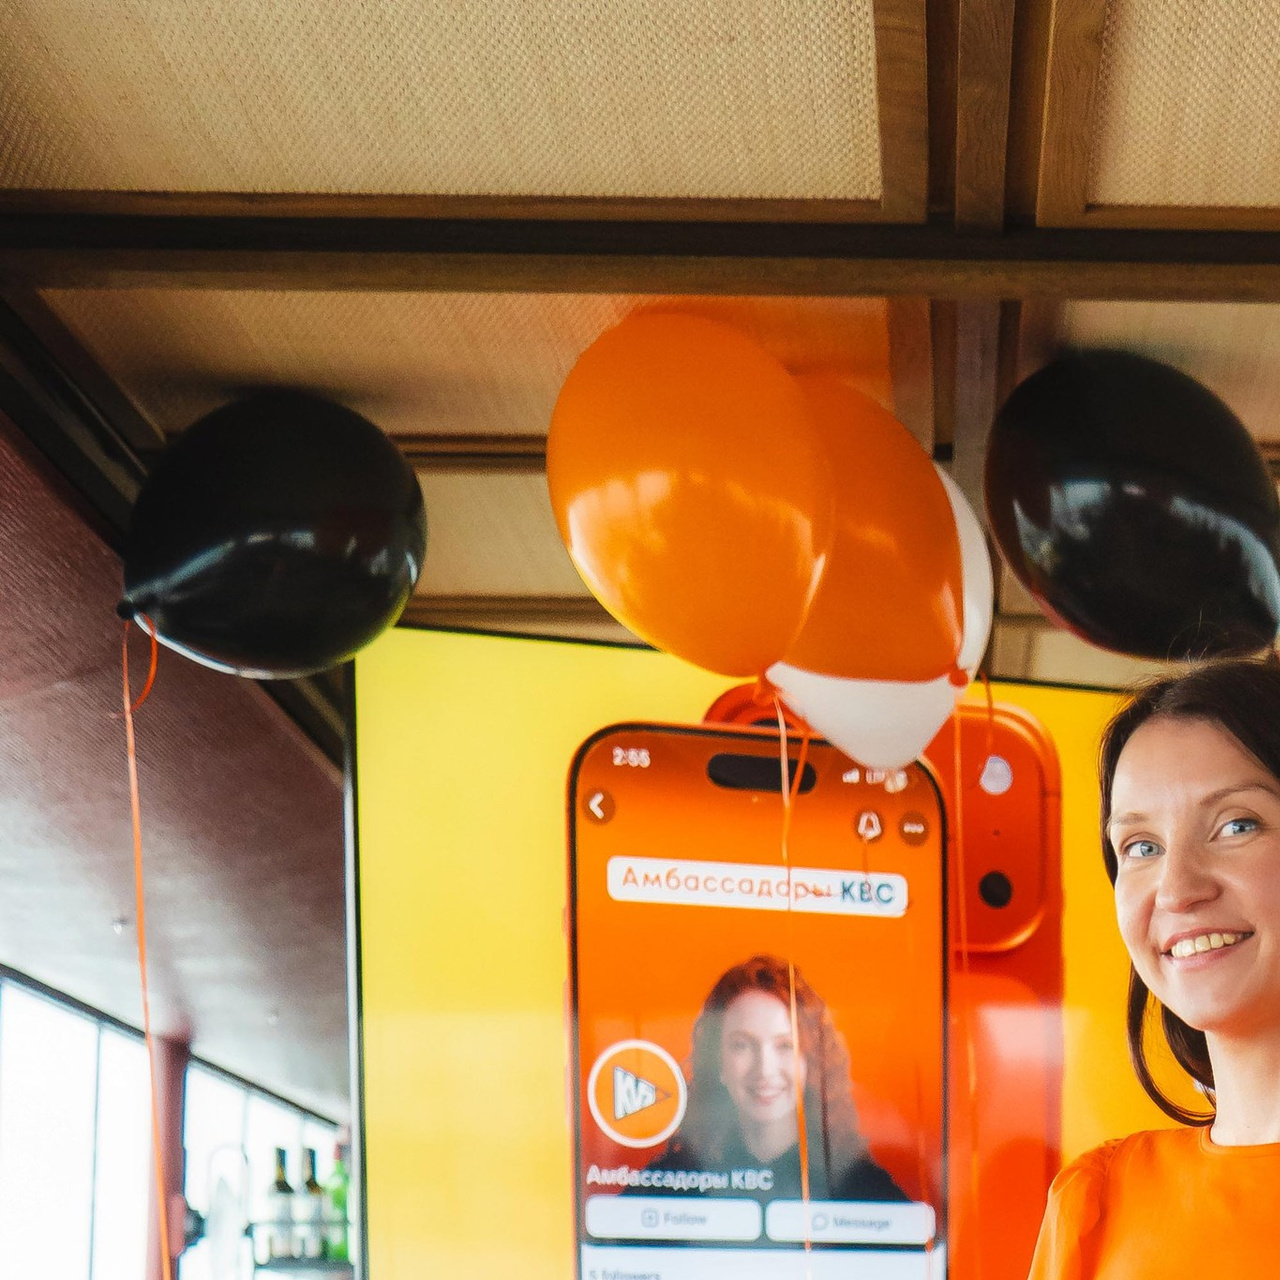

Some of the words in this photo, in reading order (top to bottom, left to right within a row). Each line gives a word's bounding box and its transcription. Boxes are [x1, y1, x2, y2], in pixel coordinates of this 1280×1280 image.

[622, 865, 832, 901] Амбассадоры
[841, 880, 894, 904] КВС
[586, 1165, 729, 1193] Амбассадоры
[731, 1169, 774, 1191] КВС
[663, 1212, 707, 1226] Follow
